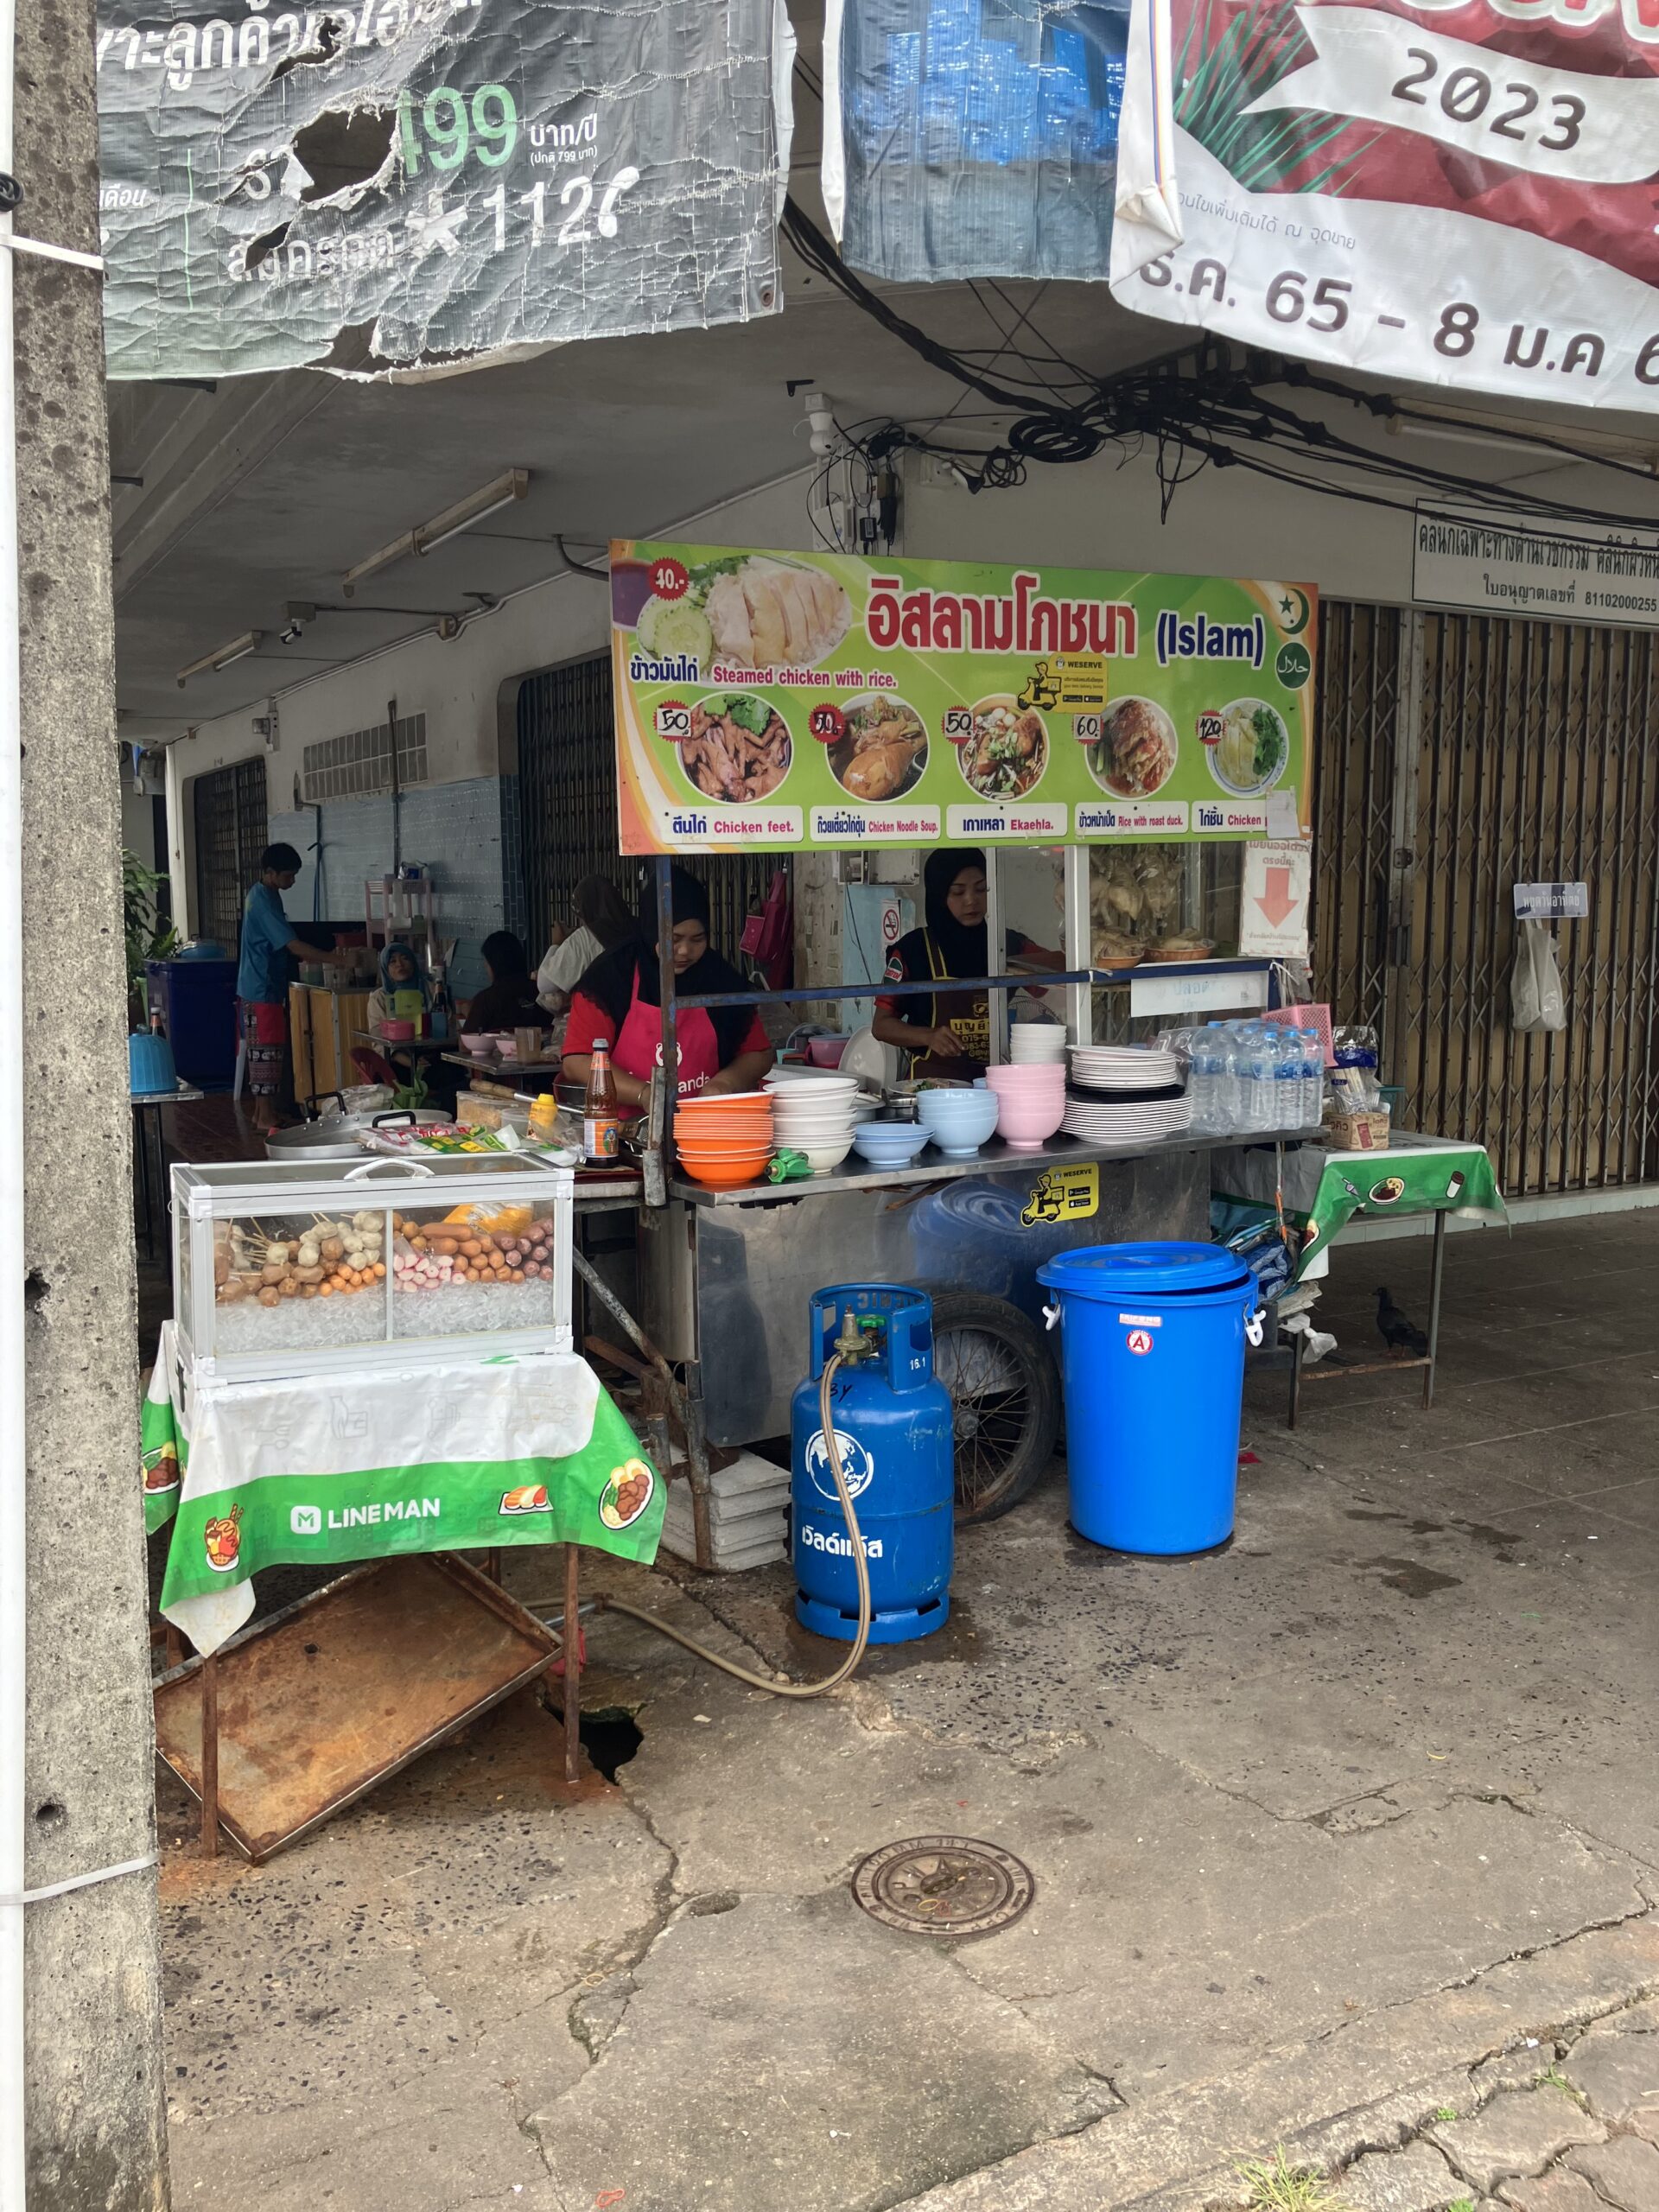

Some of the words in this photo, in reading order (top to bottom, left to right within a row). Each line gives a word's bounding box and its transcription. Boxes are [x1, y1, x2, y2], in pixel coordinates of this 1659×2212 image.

[1391, 48, 1586, 150] 2023
[531, 113, 598, 147] บาท/ปี
[558, 150, 576, 162] 799
[1310, 226, 1357, 250] จุดขาย
[1266, 270, 1353, 333] 65
[1432, 302, 1480, 358] 8
[1585, 591, 1657, 613] 81102000255
[868, 575, 1135, 654] อิสลามโภชนา
[1158, 613, 1264, 666] (Islam)
[631, 654, 698, 682] ข้าวมันไก่
[714, 665, 773, 684] Steamed
[779, 669, 830, 685] chicken
[836, 671, 863, 687] with
[868, 671, 896, 688] rice.
[1277, 656, 1308, 673] حلال
[673, 814, 707, 834] ตีนไก่
[715, 821, 762, 833] Chicken
[768, 820, 794, 833] feet.
[963, 818, 1005, 831] เกาเหลา
[1011, 819, 1053, 831] Ekaehla.
[1079, 810, 1116, 827] ข้าวหน้าเป็ด
[1118, 816, 1131, 827] Rice
[1134, 815, 1147, 827] with
[1149, 816, 1165, 827] roast
[1166, 814, 1183, 826] duck.
[1198, 805, 1223, 826] ไก่ชิ้น
[1228, 814, 1262, 826] Chicken
[868, 820, 894, 833] Chicken
[897, 819, 918, 832] Noodle
[920, 819, 938, 834] Soup.
[1064, 1168, 1092, 1178] WESERVE
[1132, 1334, 1146, 1351] A
[910, 1357, 926, 1370] 16.1
[328, 1503, 381, 1529] LINE
[385, 1497, 441, 1522] MAN
